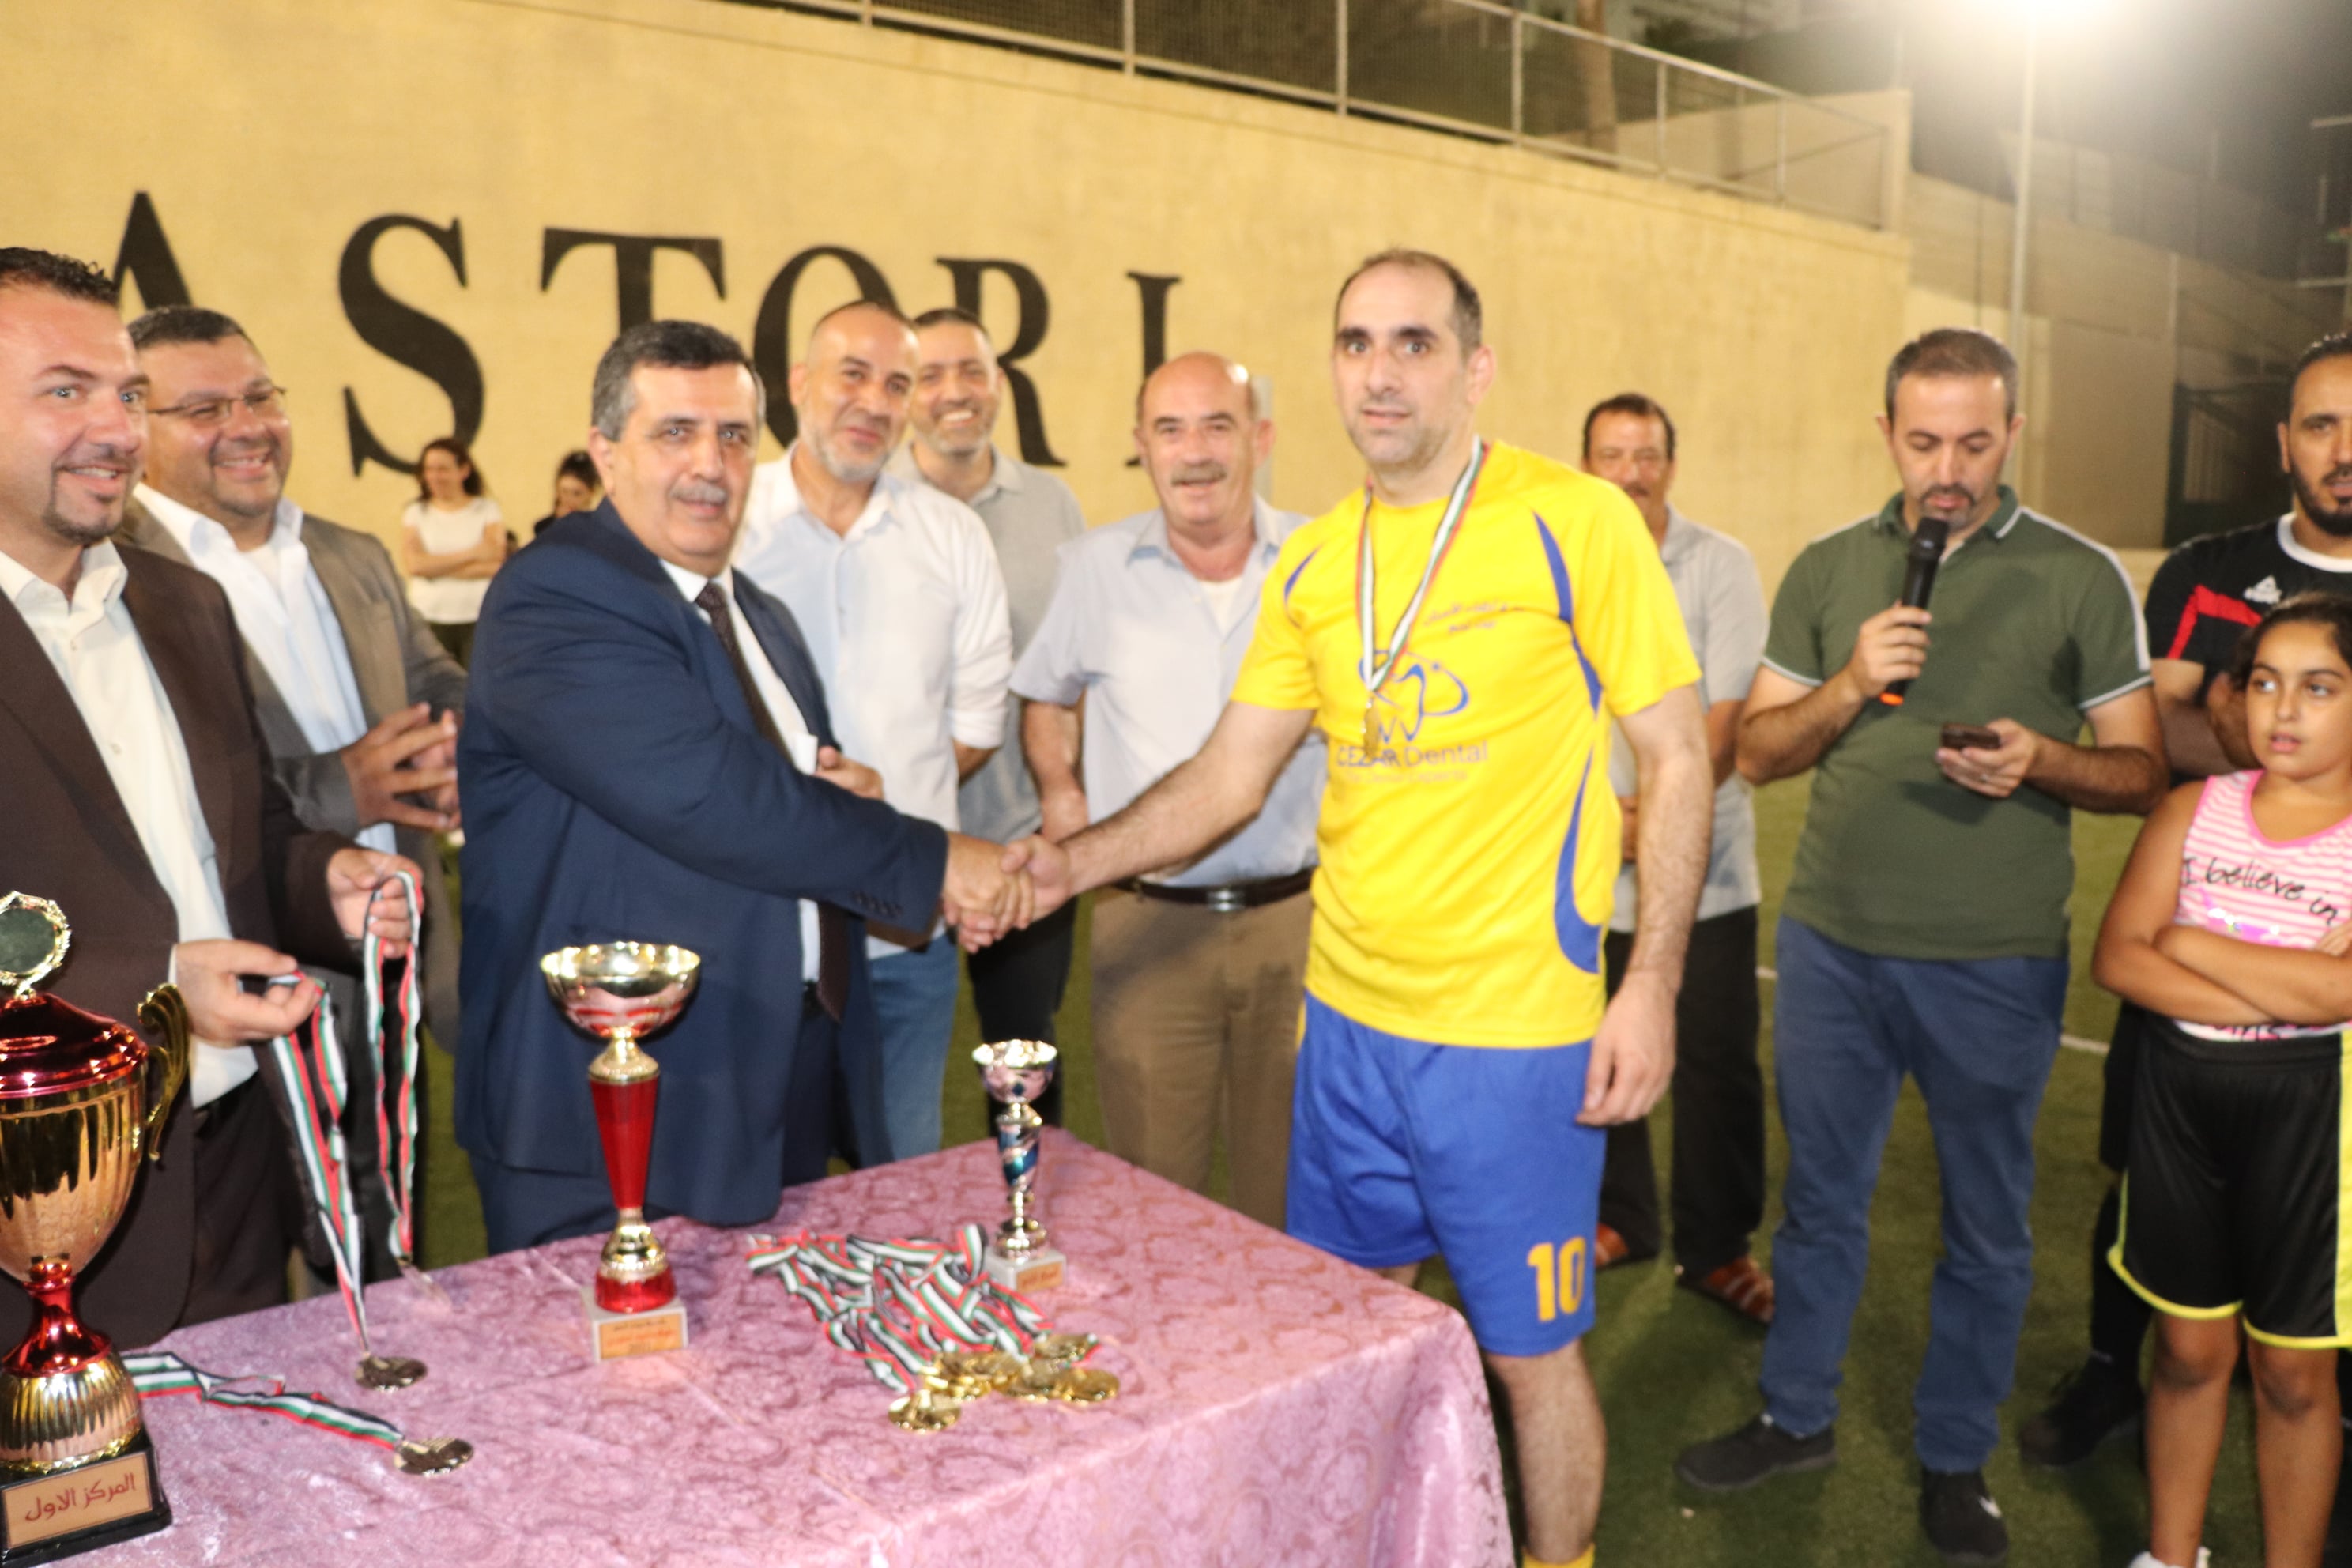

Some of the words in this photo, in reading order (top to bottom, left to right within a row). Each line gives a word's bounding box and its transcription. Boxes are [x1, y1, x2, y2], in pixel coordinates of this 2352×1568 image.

[1404, 740, 1489, 767] Dental
[2183, 857, 2197, 885] I
[2205, 858, 2305, 900] believe
[2309, 891, 2338, 925] in
[1527, 1236, 1587, 1323] 10
[25, 1486, 77, 1521] الاول
[83, 1472, 136, 1509] المركز
